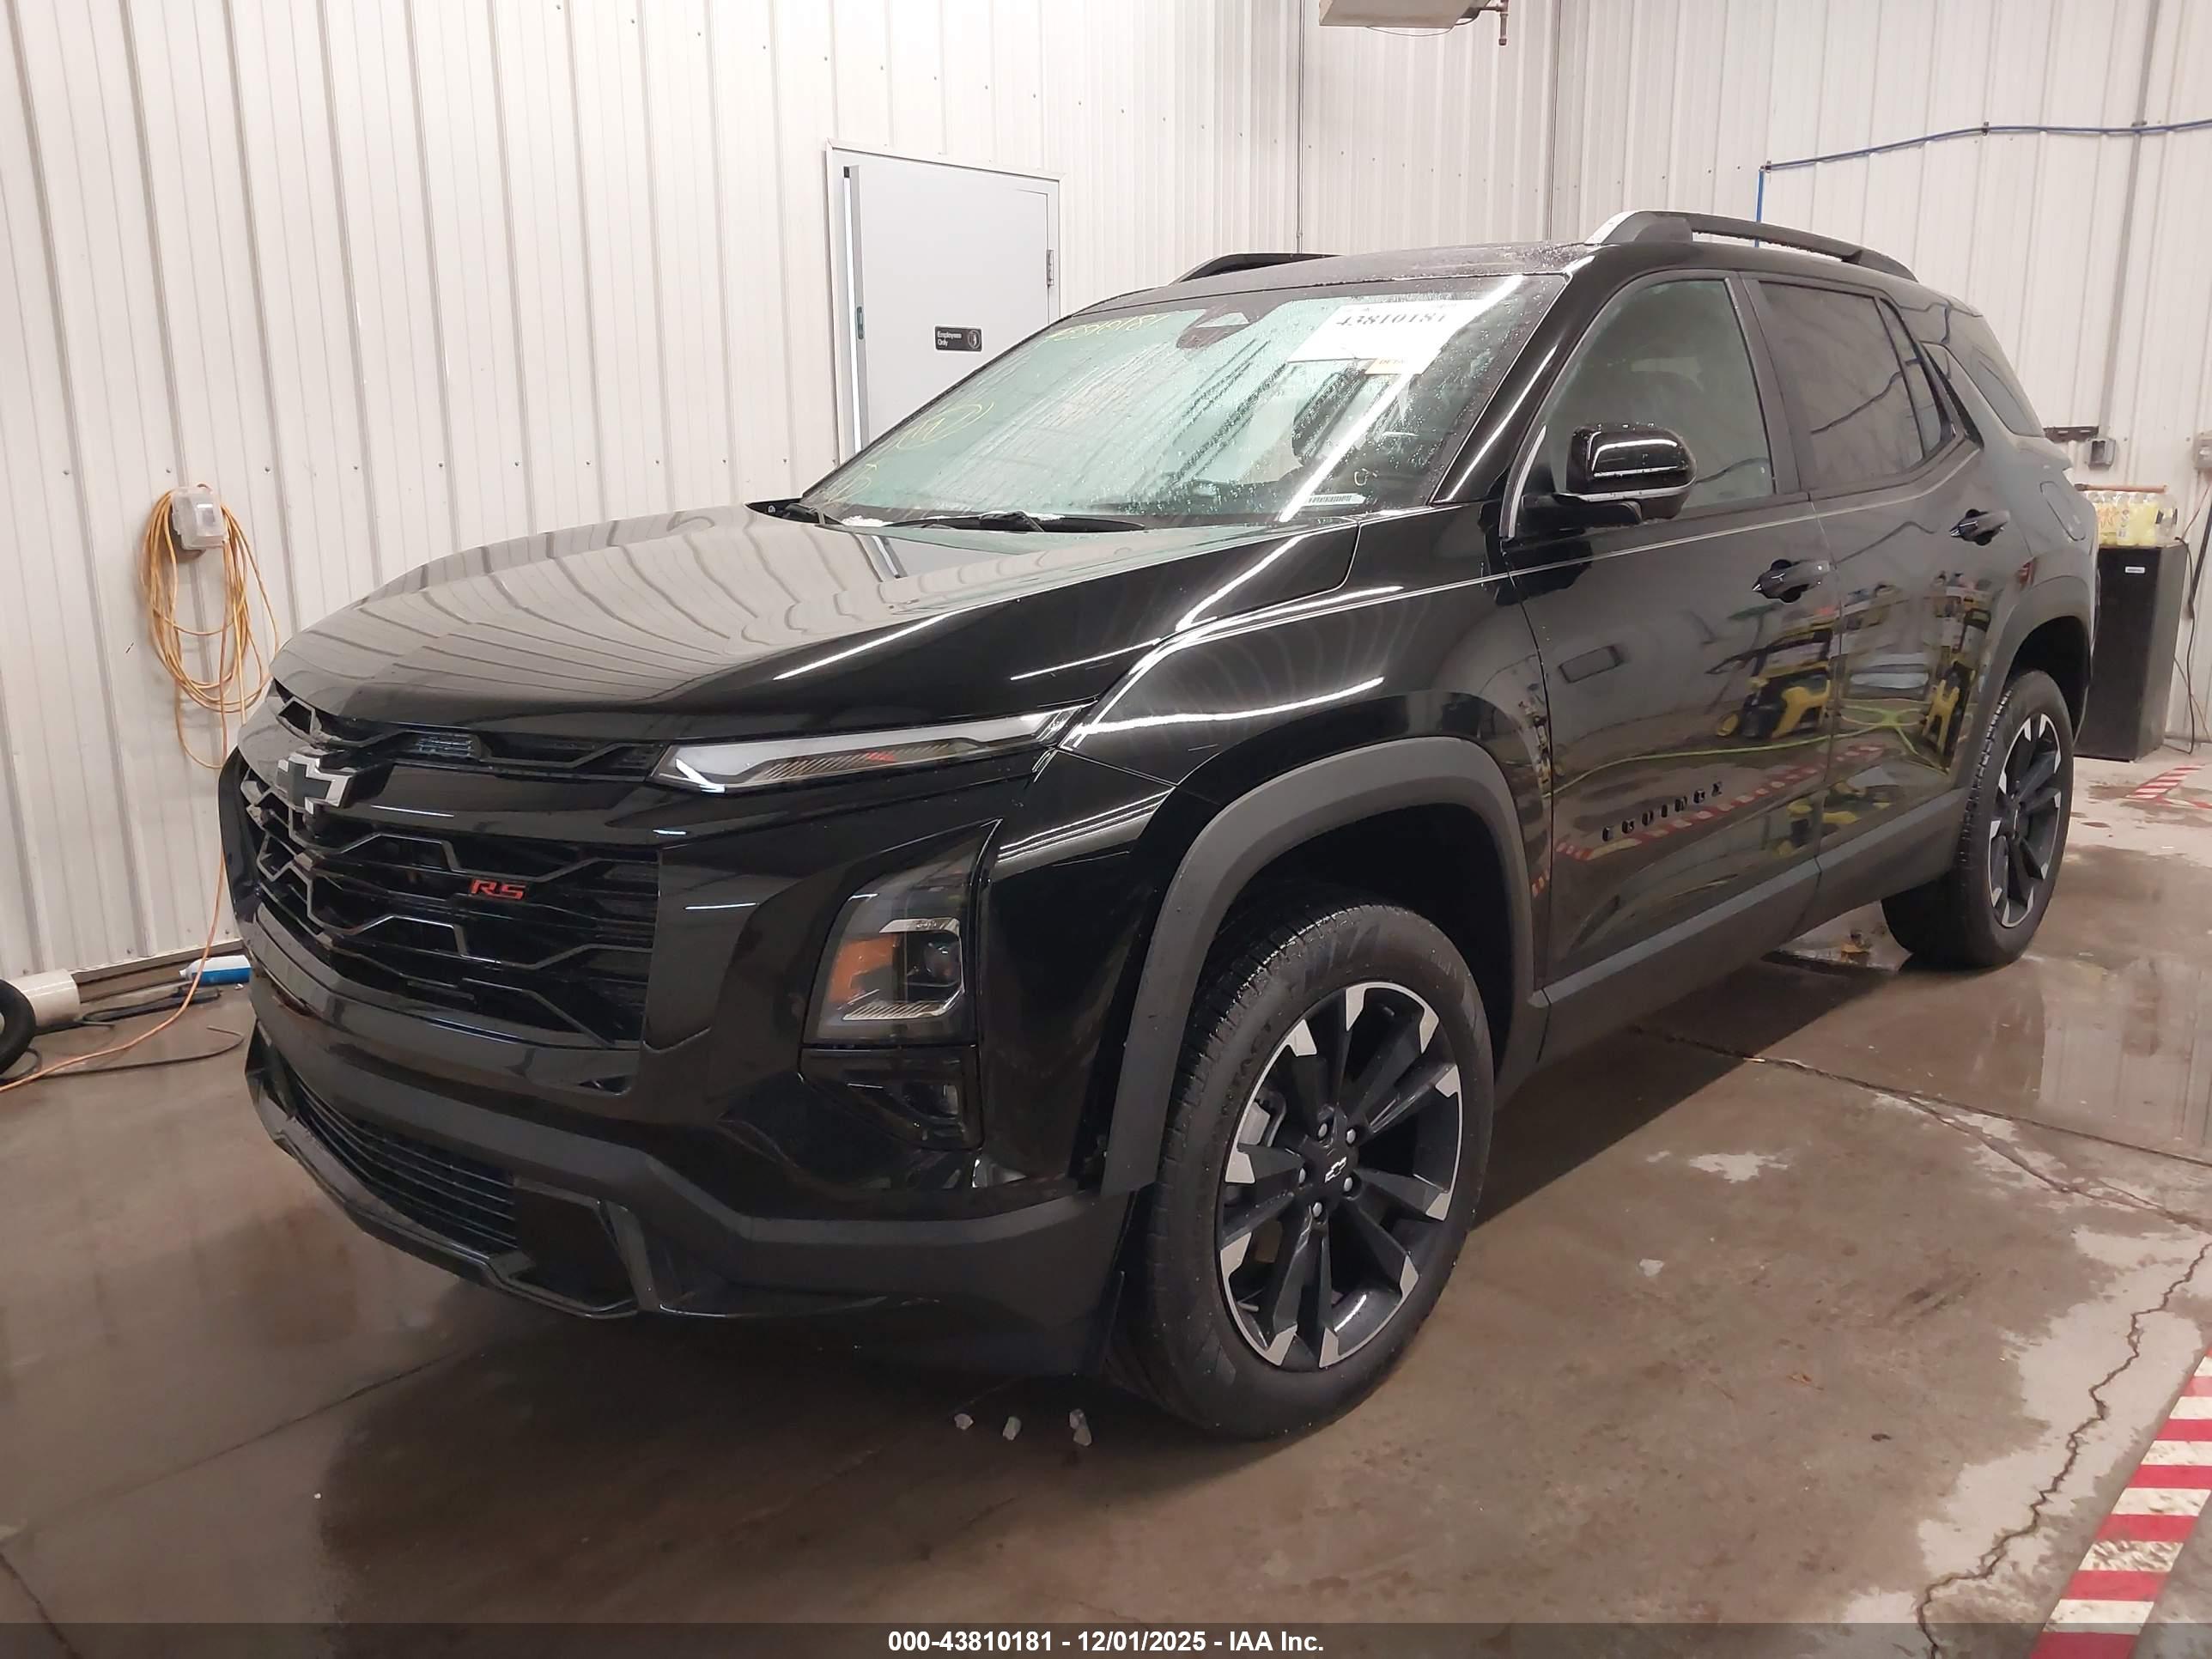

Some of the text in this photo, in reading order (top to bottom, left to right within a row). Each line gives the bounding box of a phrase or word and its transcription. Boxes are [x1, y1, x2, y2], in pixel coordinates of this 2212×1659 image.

[937, 331, 962, 339] Employees
[937, 338, 949, 347] Only
[470, 878, 526, 900] RS
